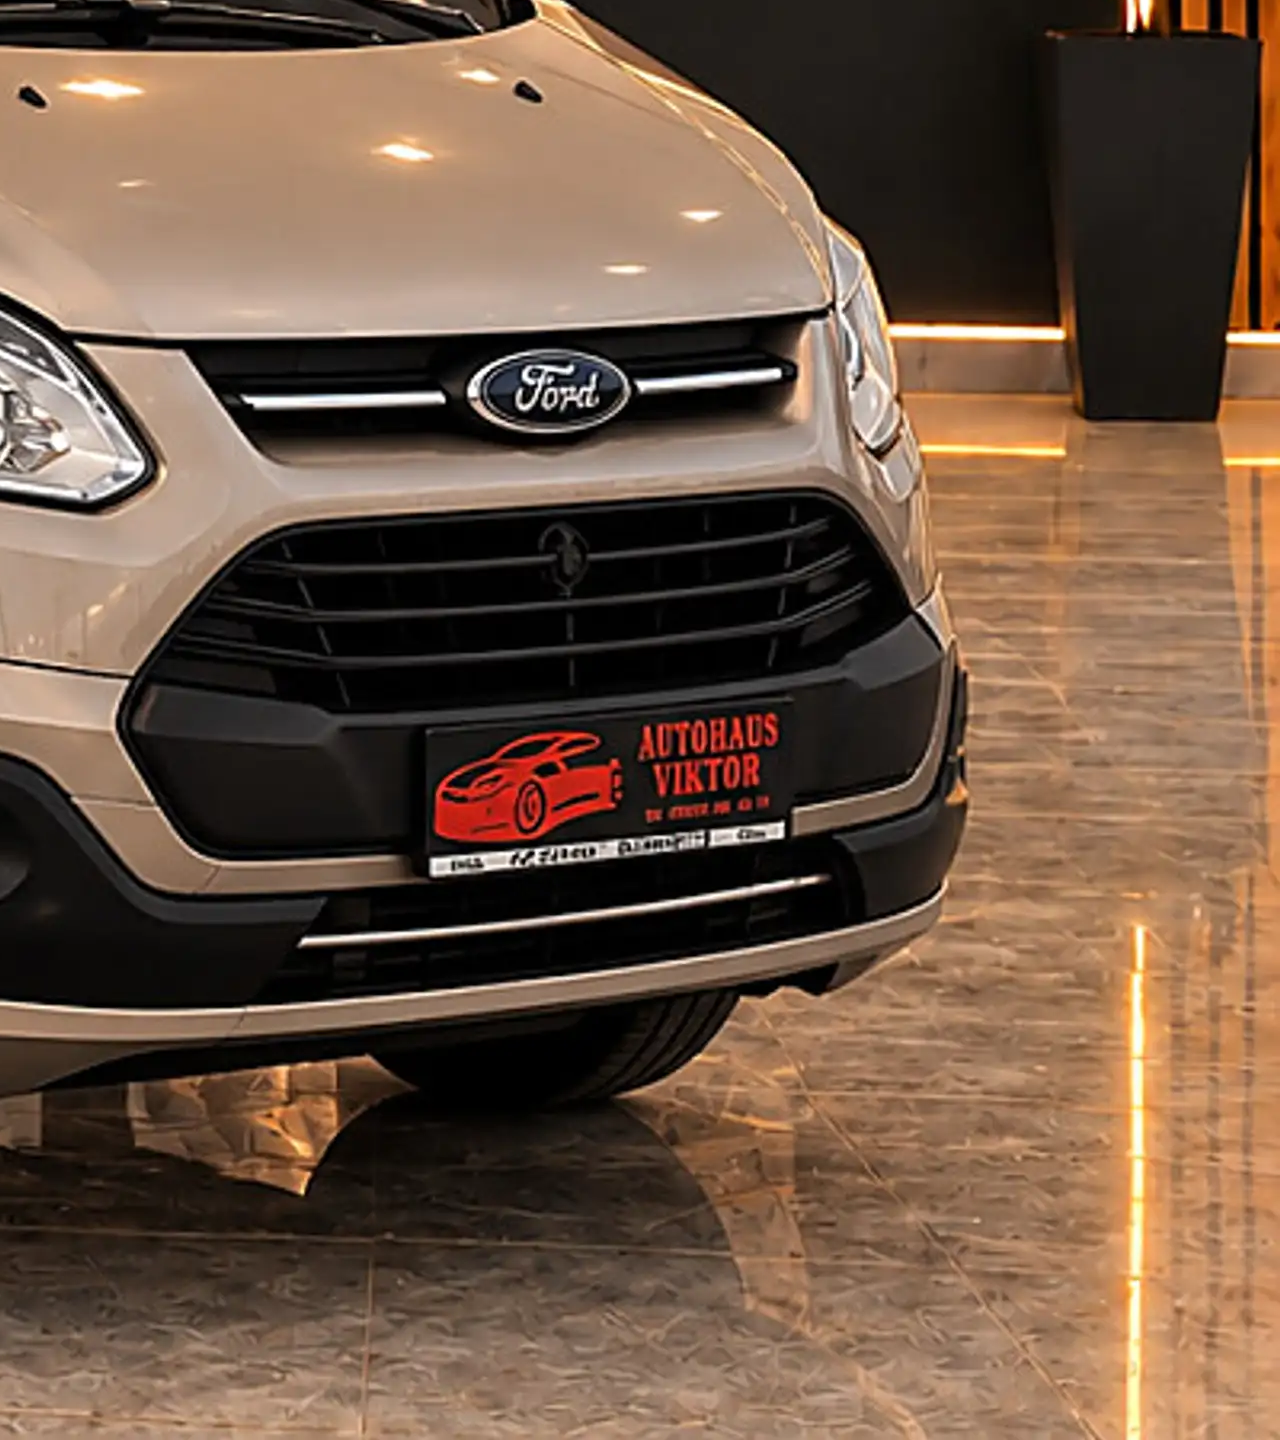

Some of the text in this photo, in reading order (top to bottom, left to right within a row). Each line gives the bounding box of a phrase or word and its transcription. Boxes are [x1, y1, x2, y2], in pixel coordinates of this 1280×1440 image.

[515, 363, 600, 412] Ford
[638, 712, 779, 760] AUTOHAUS
[651, 755, 761, 798] VIKTOR
